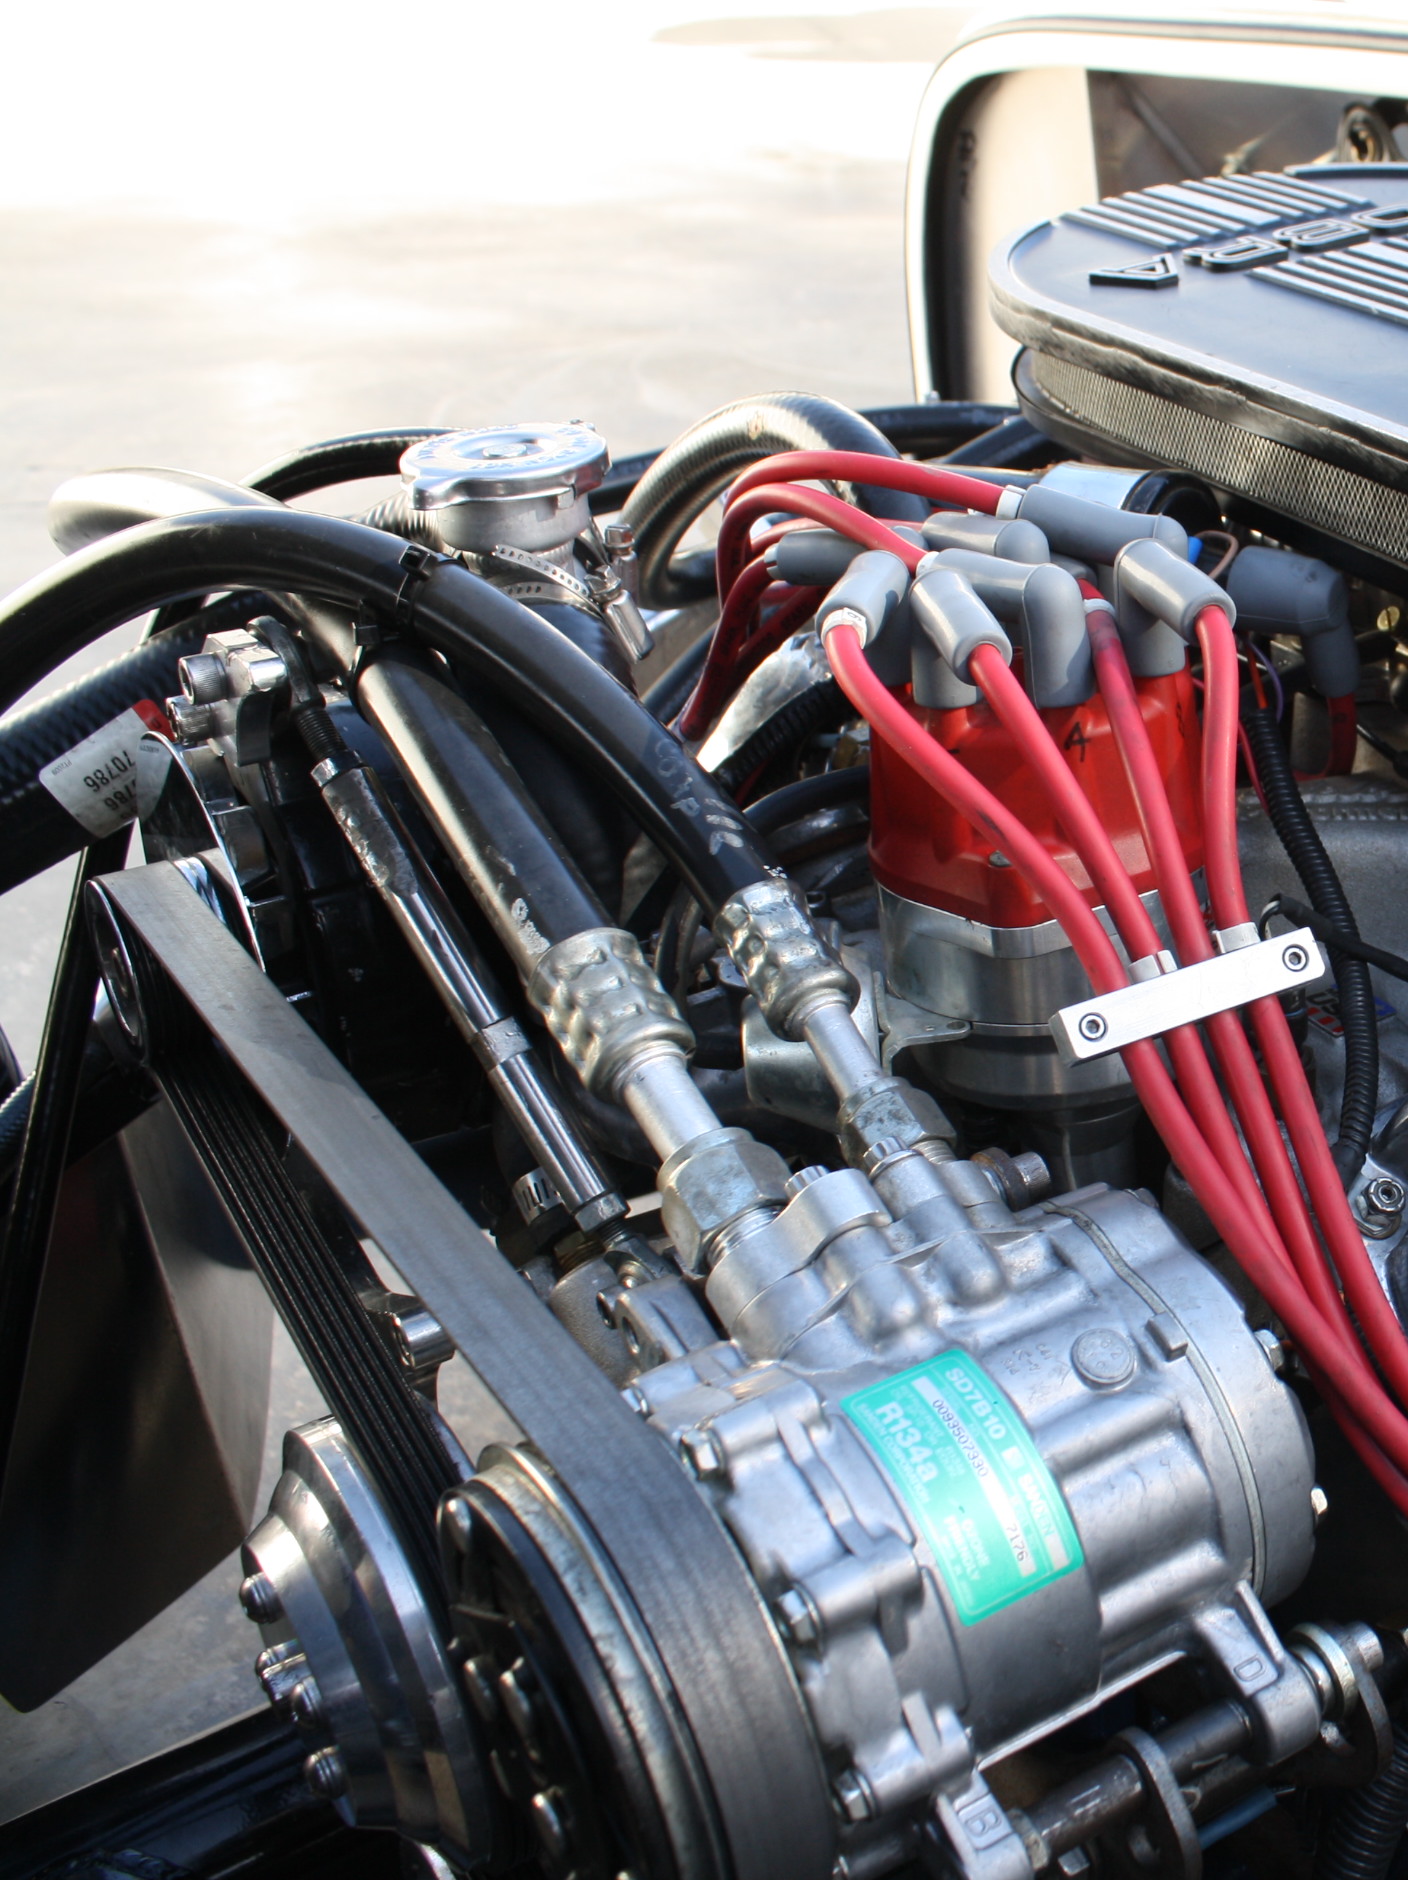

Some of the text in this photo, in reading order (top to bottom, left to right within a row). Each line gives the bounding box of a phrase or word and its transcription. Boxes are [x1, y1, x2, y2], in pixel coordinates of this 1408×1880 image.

[1063, 722, 1091, 763] 4
[84, 751, 135, 793] 70786
[944, 1365, 1007, 1440] SD7B10
[873, 1400, 940, 1484] R134a
[1005, 1523, 1029, 1562] 7176
[1233, 1655, 1266, 1682] D
[965, 1809, 1001, 1835] B
